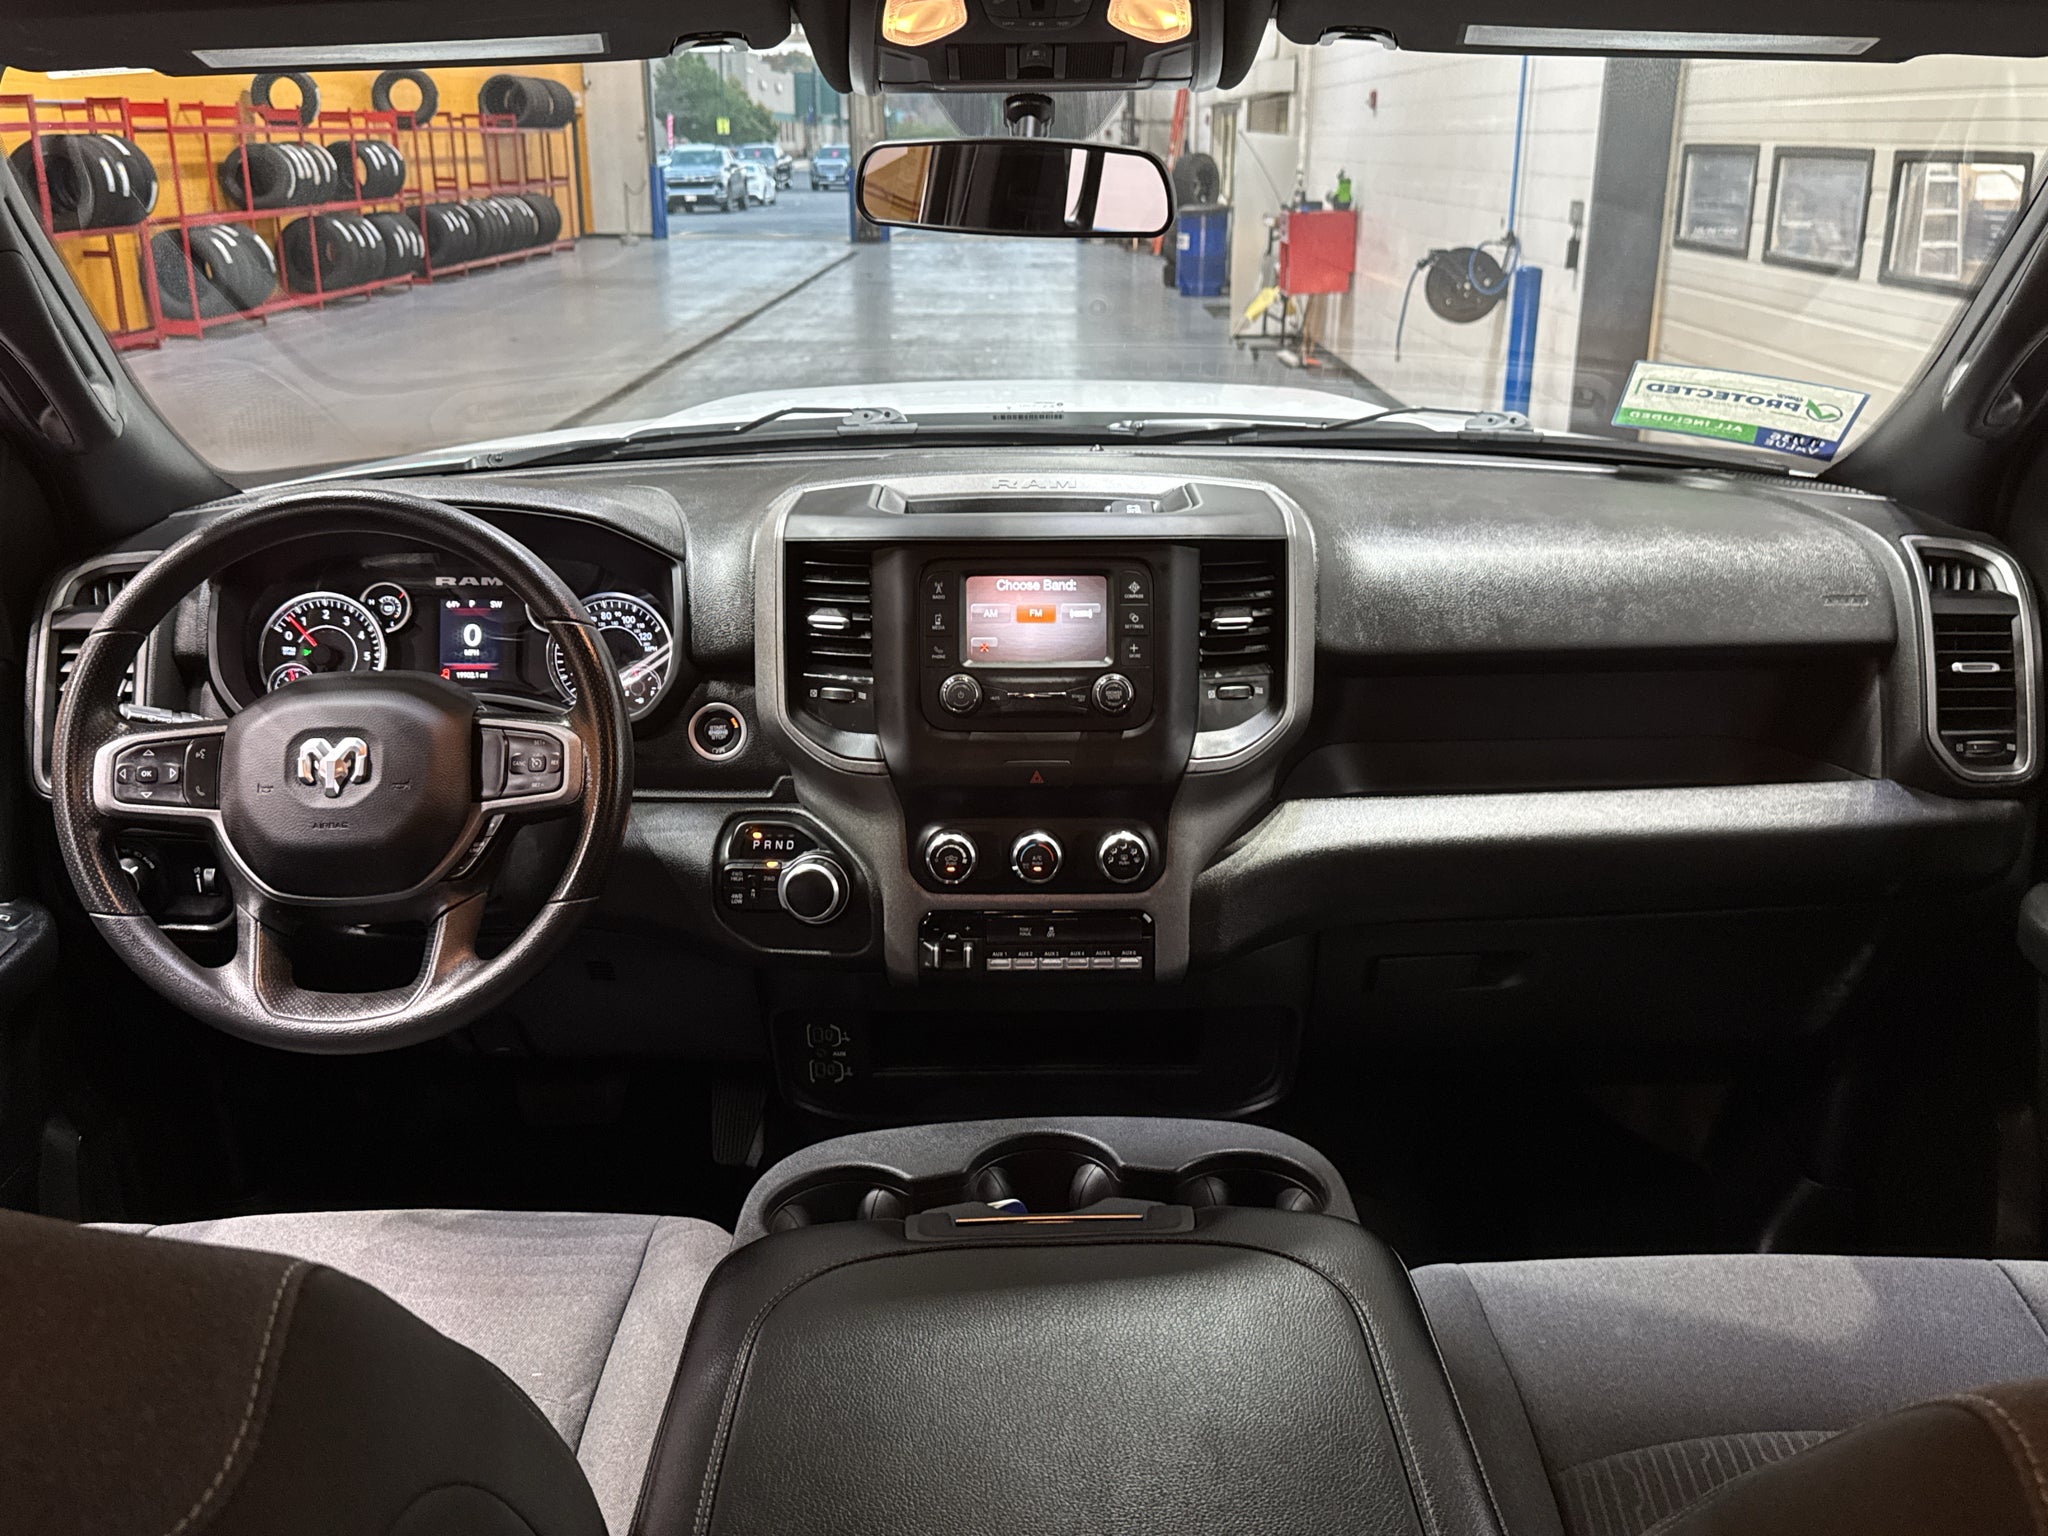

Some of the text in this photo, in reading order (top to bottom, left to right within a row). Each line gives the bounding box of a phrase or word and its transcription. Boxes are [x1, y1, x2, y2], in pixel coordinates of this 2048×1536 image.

[992, 479, 1077, 489] RAM
[435, 576, 504, 586] RAM
[996, 579, 1077, 592] Choose Band:
[322, 609, 331, 620] 2
[600, 612, 612, 620] 80
[983, 609, 998, 618] AM
[1029, 609, 1043, 617] FM
[300, 616, 307, 626] 1
[342, 616, 351, 626] 3
[621, 616, 636, 624] 100
[284, 631, 294, 641] 0
[357, 631, 365, 640] 4
[463, 623, 482, 647] 0
[639, 633, 653, 641] 120
[363, 651, 371, 661] 5
[140, 770, 152, 778] OK
